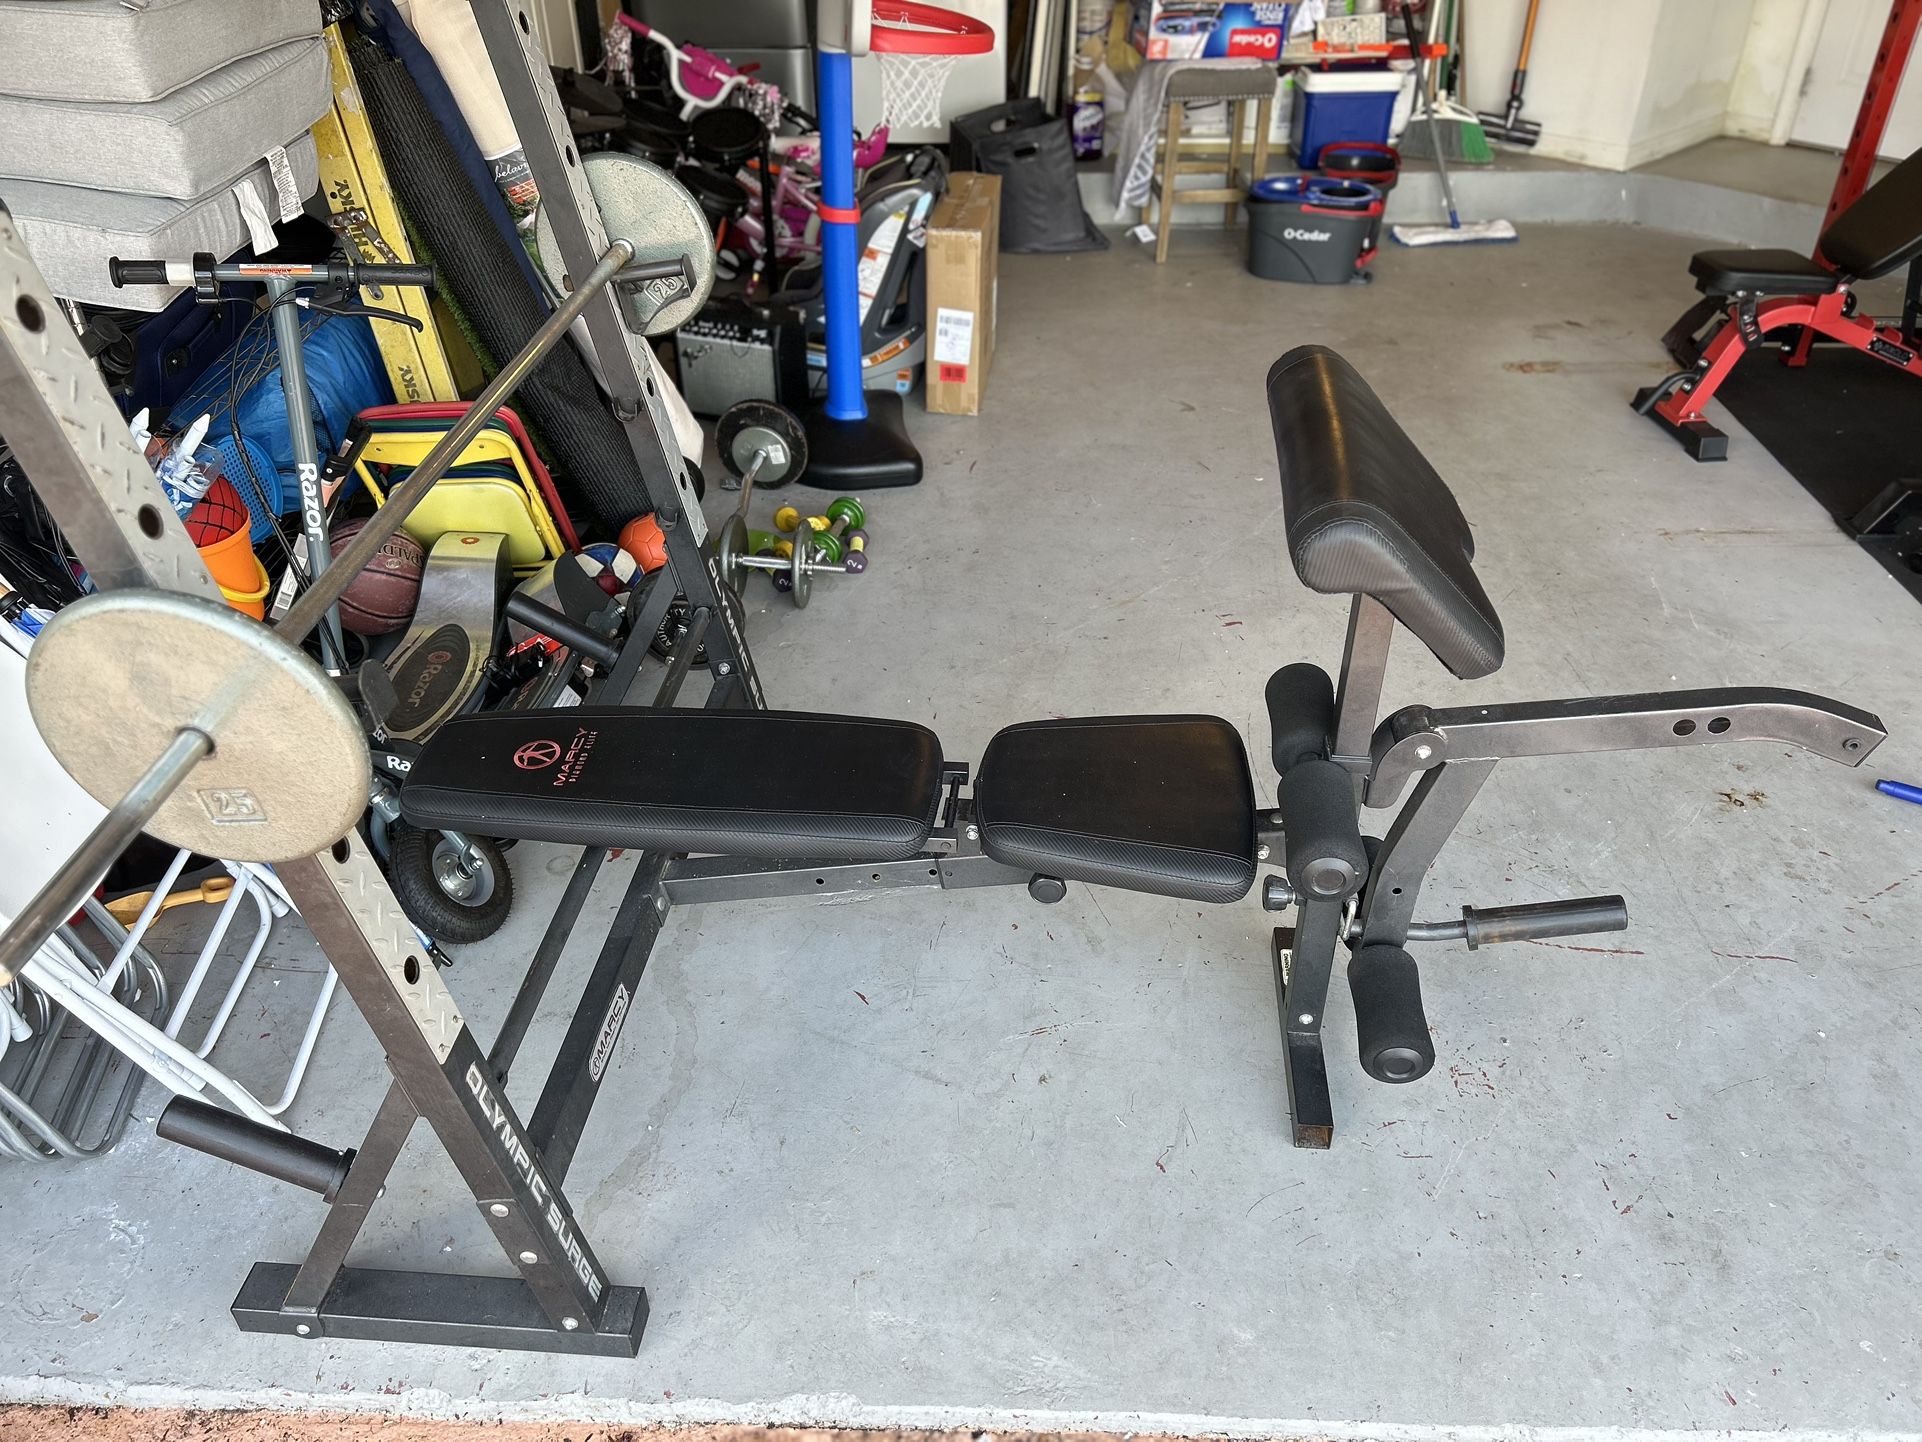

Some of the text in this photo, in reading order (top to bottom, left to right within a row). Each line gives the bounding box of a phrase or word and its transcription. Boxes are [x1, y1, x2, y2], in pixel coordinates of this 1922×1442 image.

[652, 276, 678, 300] 25
[552, 727, 588, 786] MARCY
[210, 790, 257, 816] 25
[597, 987, 626, 1060] MARCY
[465, 1060, 603, 1304] OLYMPIC SURGE
